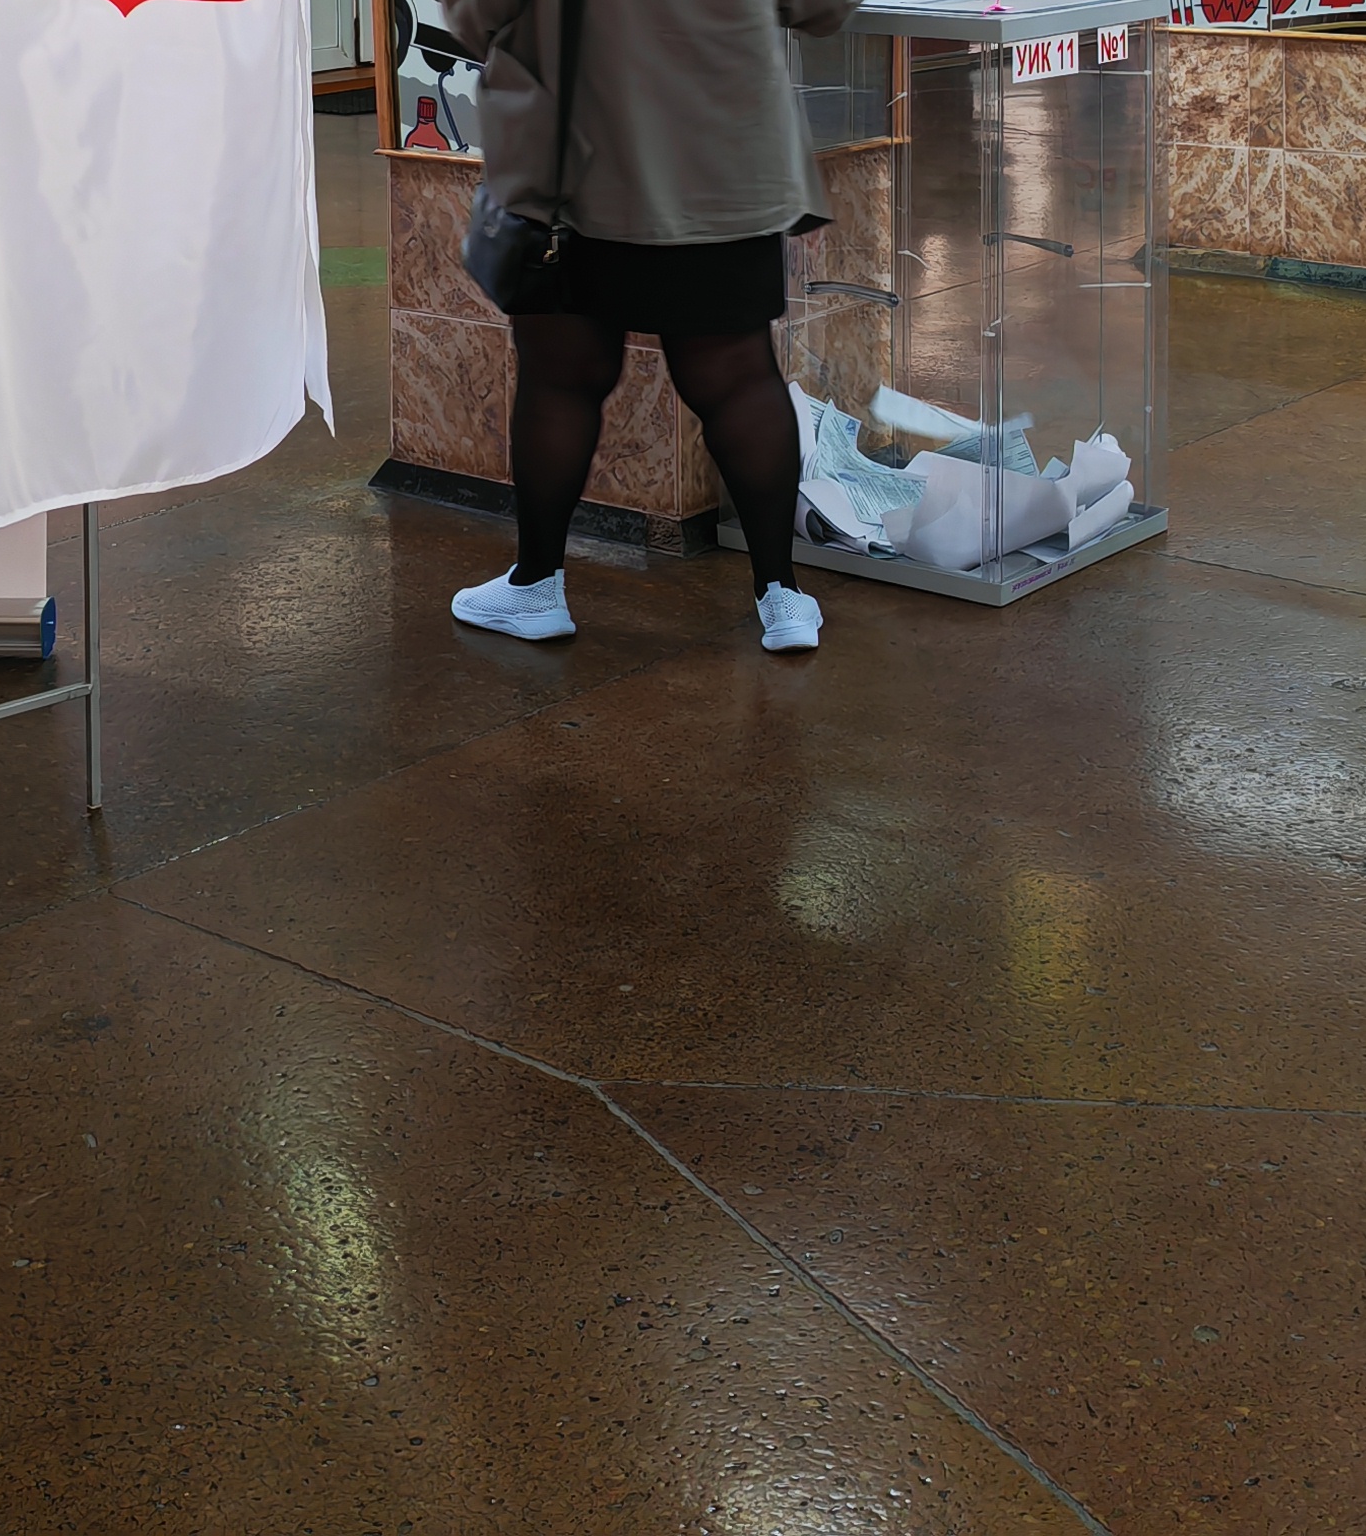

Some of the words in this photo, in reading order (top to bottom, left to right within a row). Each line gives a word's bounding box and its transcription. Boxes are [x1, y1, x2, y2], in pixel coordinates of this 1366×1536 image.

[1016, 41, 1051, 76] УИК
[1057, 37, 1075, 71] 11
[1100, 28, 1127, 61] №1
